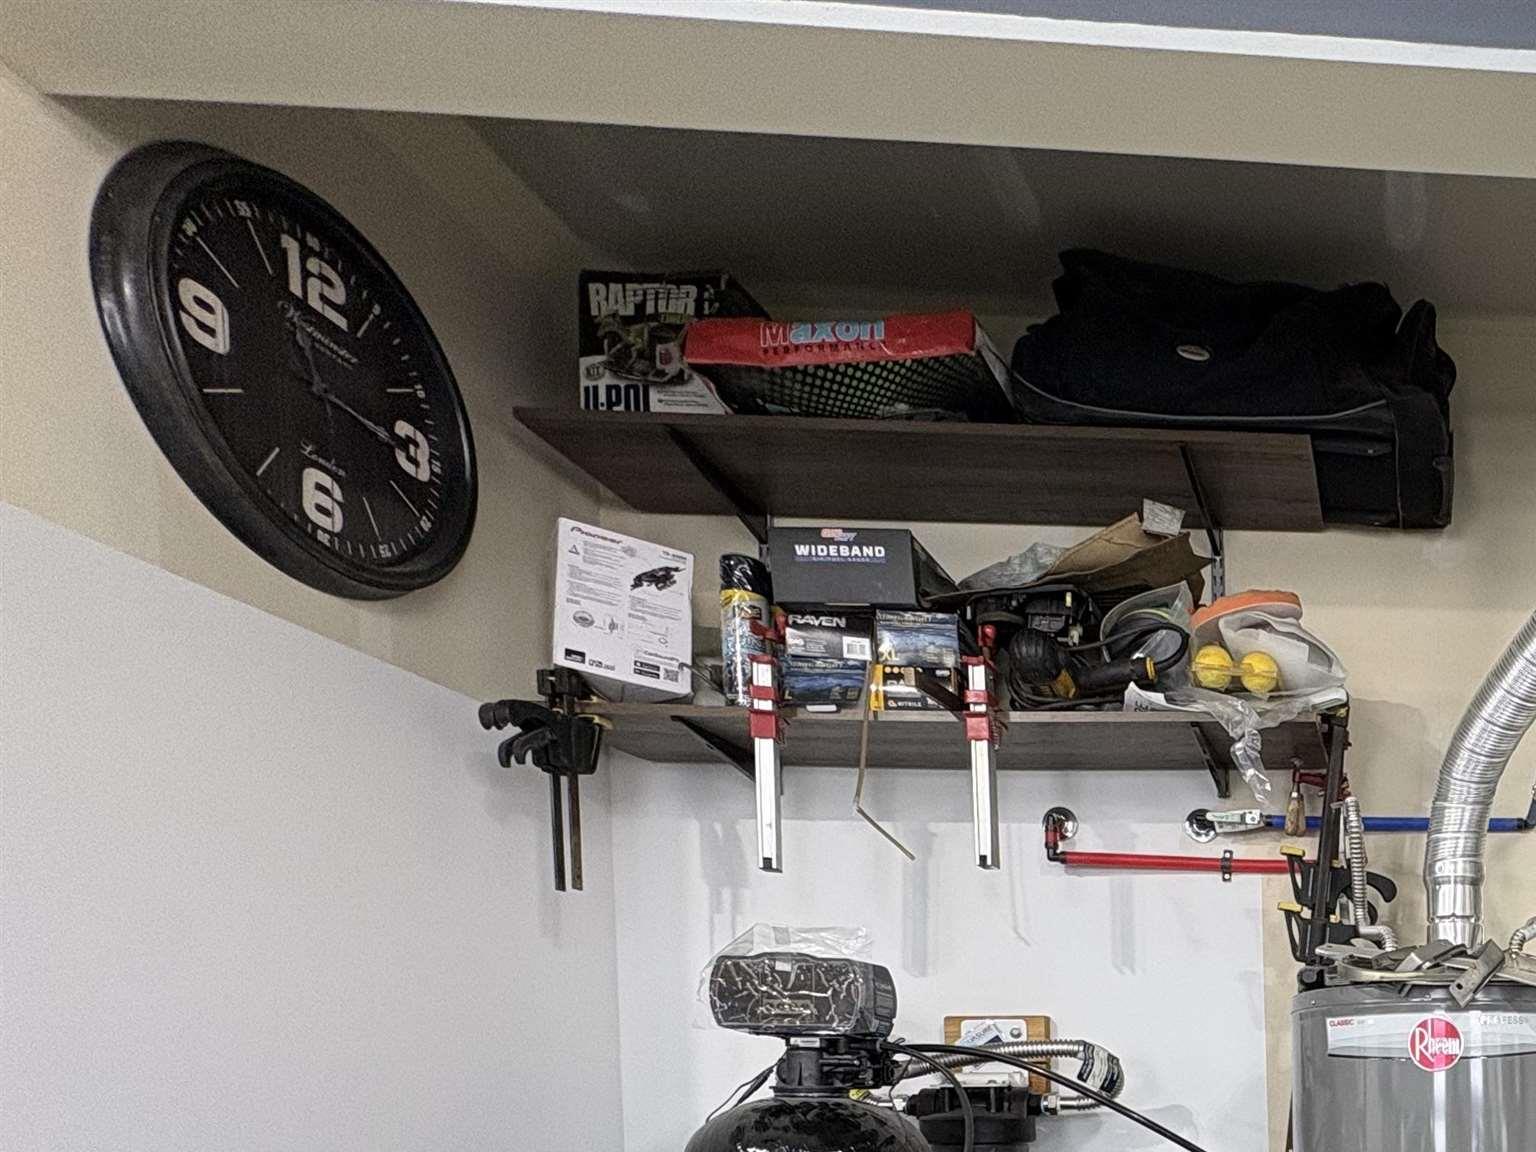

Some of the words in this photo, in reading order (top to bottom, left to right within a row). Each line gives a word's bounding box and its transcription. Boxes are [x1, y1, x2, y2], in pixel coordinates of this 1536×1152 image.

[281, 234, 348, 332] 12
[588, 282, 698, 316] RAPTOR
[178, 277, 230, 356] 9
[394, 419, 431, 483] 3
[303, 467, 343, 533] 6
[794, 544, 886, 557] WIDEBAND
[788, 614, 847, 628] RAVEN
[1415, 1018, 1460, 1062] Rheem
